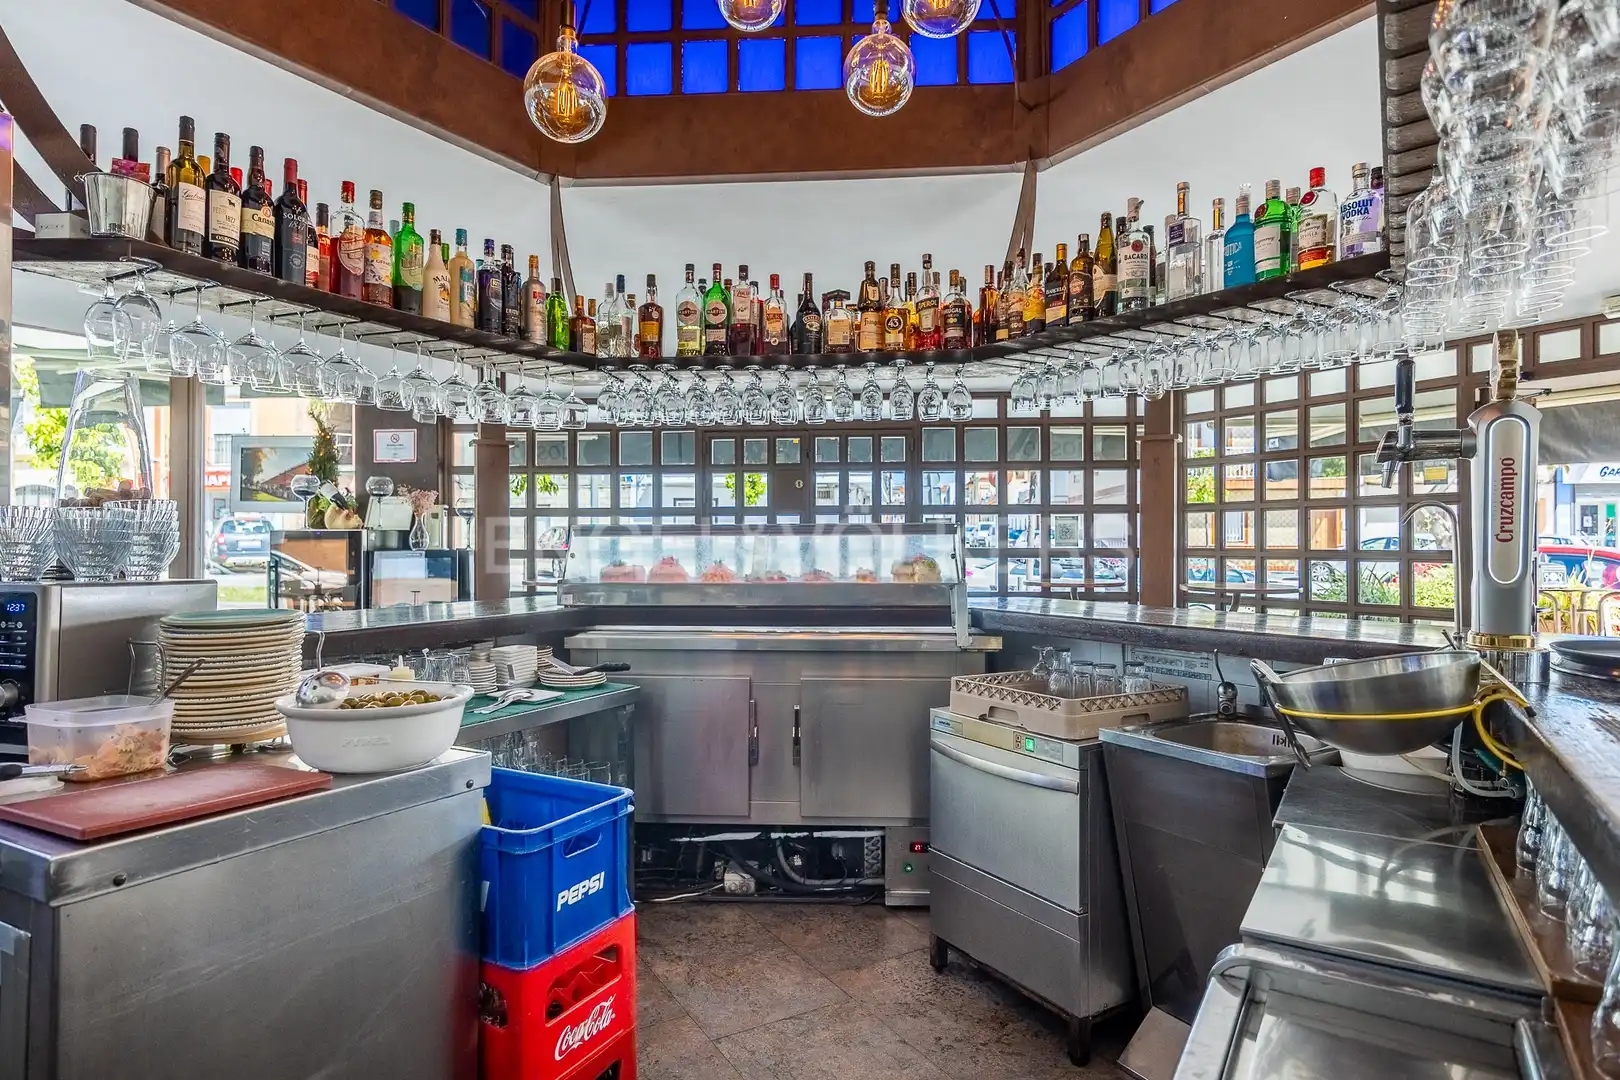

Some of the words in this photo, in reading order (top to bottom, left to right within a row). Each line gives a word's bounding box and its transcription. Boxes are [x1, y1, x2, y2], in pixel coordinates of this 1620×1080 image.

[1341, 206, 1370, 220] VODKA
[887, 318, 900, 327] 43
[1494, 456, 1518, 543] Cruzcampo
[556, 870, 605, 912] PEPSI
